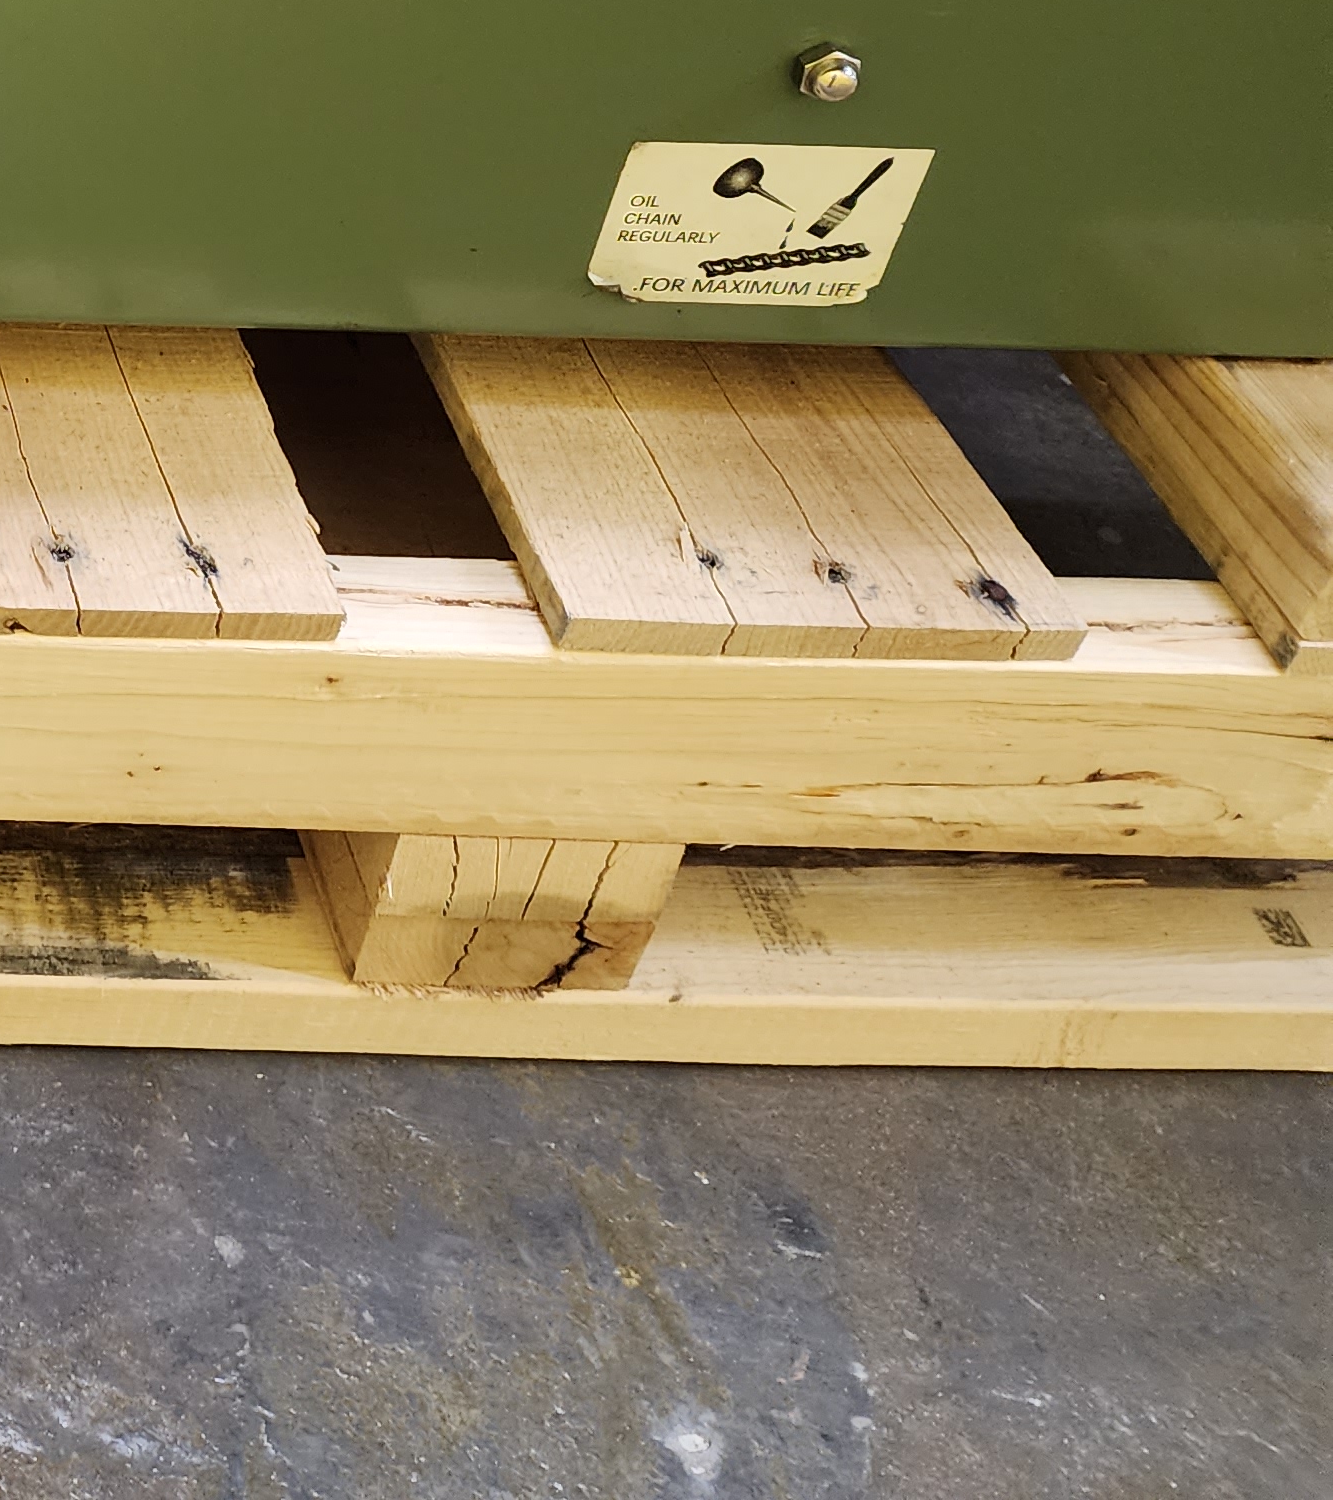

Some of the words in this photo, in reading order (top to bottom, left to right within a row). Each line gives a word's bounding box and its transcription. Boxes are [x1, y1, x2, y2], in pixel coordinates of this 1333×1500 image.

[630, 195, 660, 208] OIL
[624, 213, 683, 226] CHAIN
[617, 231, 721, 245] REGULARLY
[691, 279, 810, 296] MAXIMUM
[815, 282, 861, 298] LIFE
